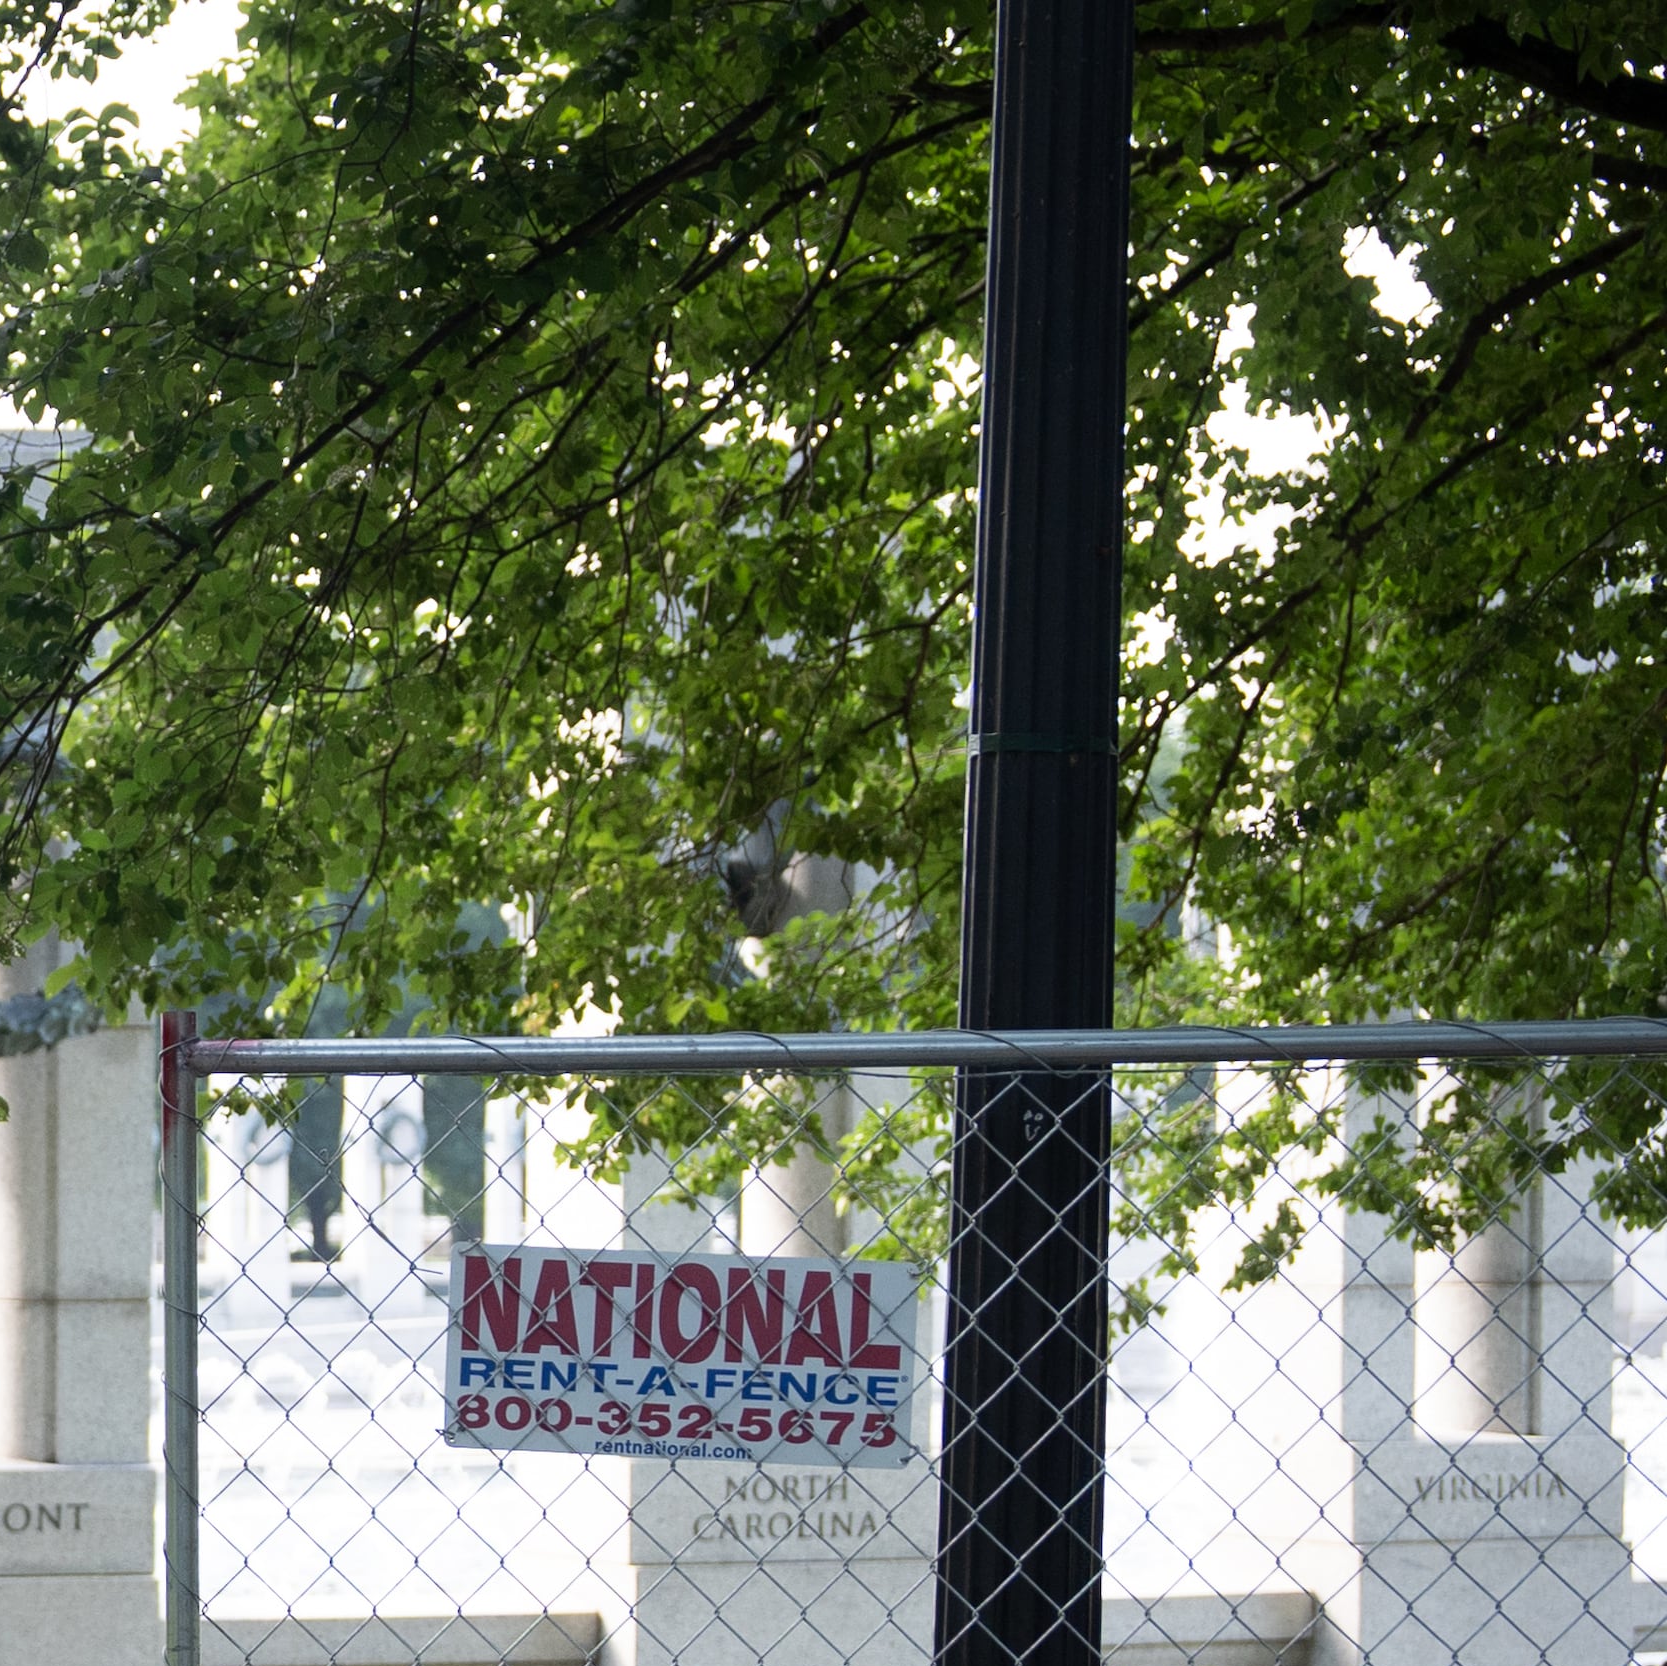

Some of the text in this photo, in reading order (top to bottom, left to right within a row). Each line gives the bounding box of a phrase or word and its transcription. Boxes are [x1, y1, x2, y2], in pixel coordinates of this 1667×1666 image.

[461, 1255, 902, 1370] NATIONAL
[459, 1356, 899, 1406] RENT-A-FENCE
[456, 1394, 897, 1448] 800-352-5675
[594, 1440, 752, 1460] rentnational.com
[725, 1475, 848, 1504] NORTH
[1415, 1472, 1566, 1504] VIRGINIA
[692, 1511, 879, 1541] CAROLINA
